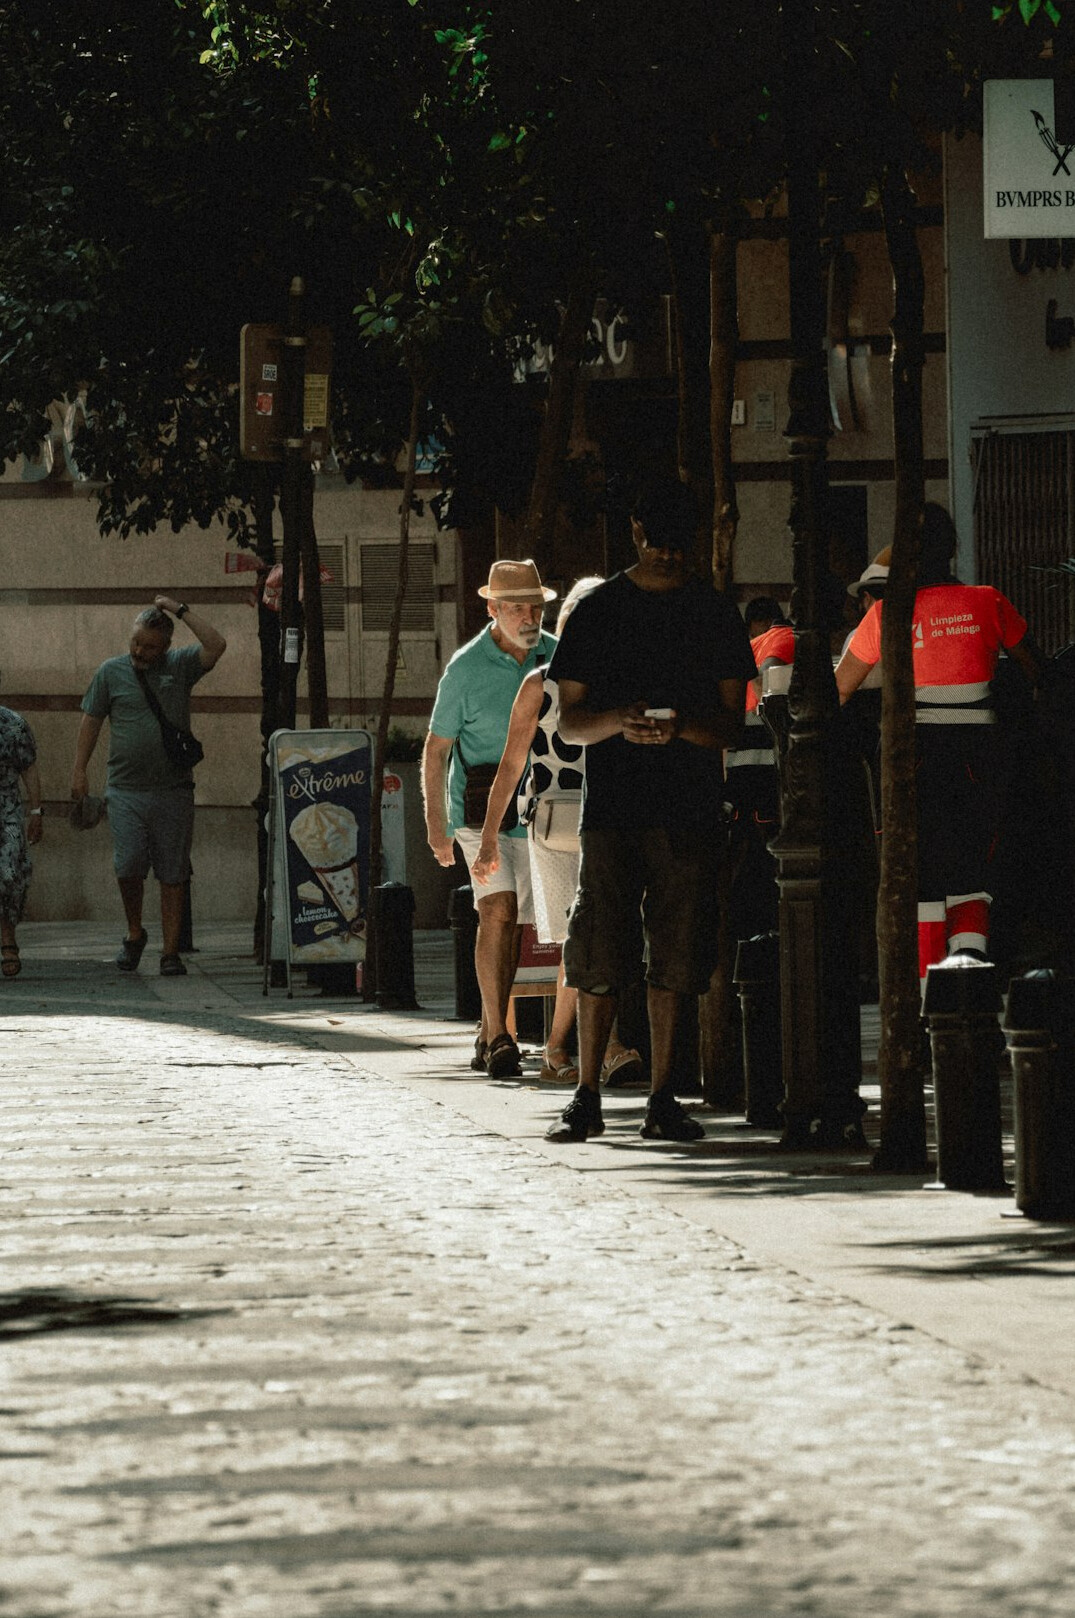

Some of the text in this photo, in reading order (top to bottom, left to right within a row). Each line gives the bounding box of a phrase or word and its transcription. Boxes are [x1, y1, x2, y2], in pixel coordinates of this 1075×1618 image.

[995, 190, 1062, 208] BVMPRS
[930, 613, 974, 626] Limpieza
[931, 624, 981, 638] de Málaga
[294, 910, 339, 924] cheesecake
[302, 906, 327, 916] lemon
